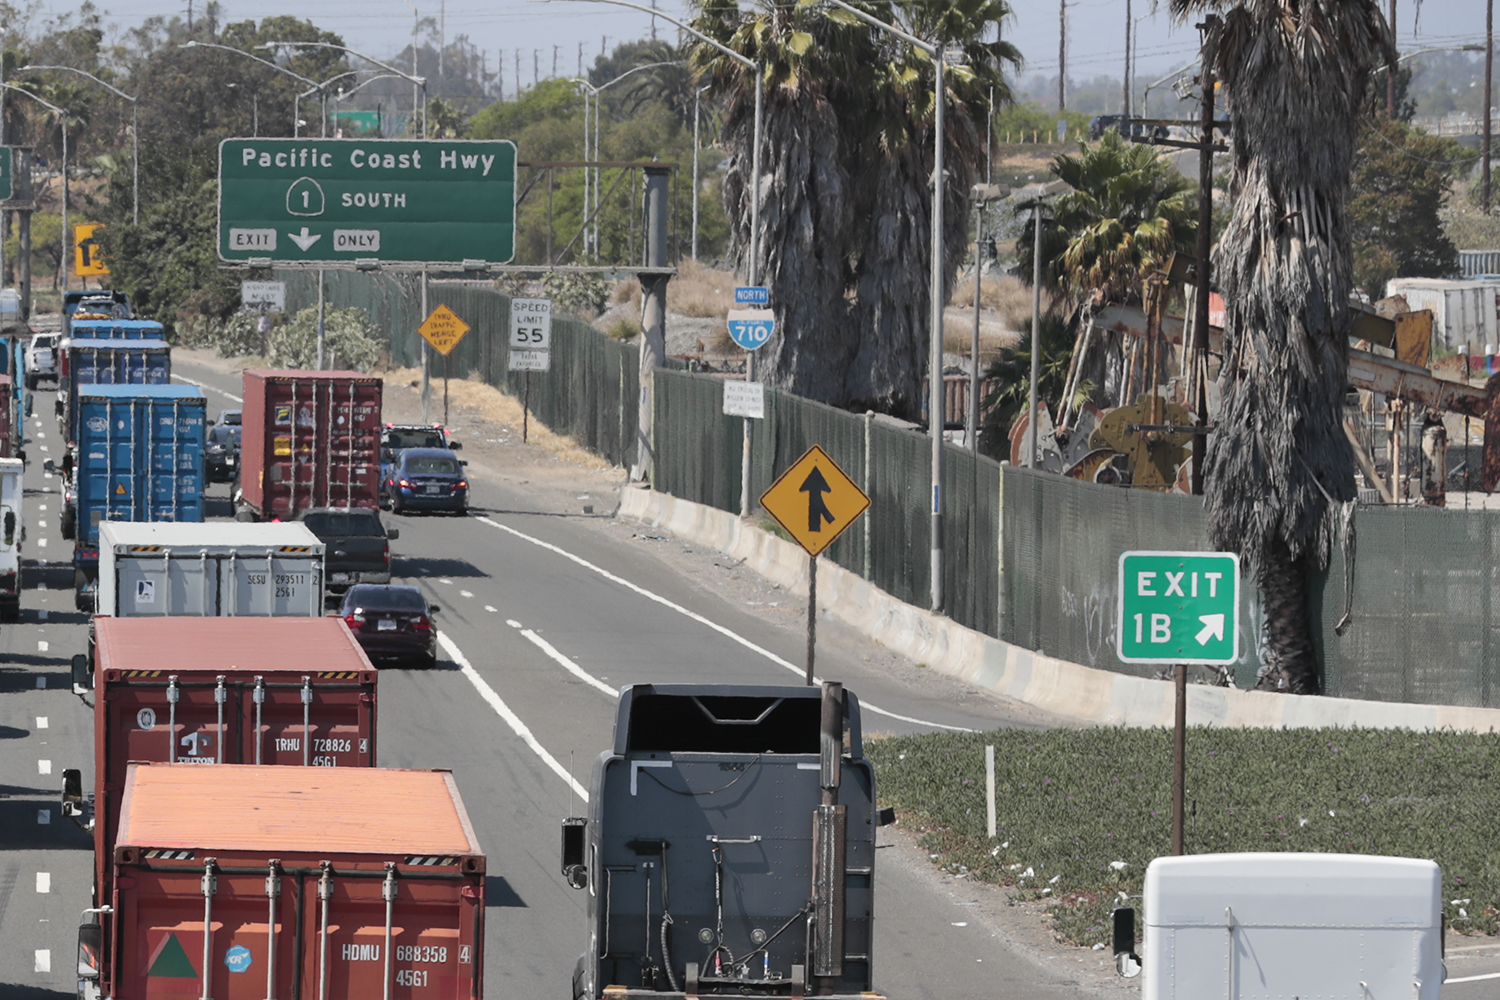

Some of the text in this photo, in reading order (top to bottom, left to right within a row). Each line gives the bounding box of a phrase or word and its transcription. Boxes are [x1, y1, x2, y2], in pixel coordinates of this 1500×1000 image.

[242, 148, 495, 176] Pacific Coast Hwy
[301, 191, 407, 209] 1 SOUTH
[236, 234, 270, 246] EXIT
[337, 235, 376, 247] ONLY
[737, 290, 766, 300] NORTH
[513, 303, 548, 312] SPEED
[517, 316, 543, 324] LIMIT
[517, 328, 543, 342] 55
[735, 326, 768, 341] 710
[248, 575, 318, 586] SESU 293511 2
[1137, 571, 1223, 598] EXIT
[1133, 612, 1172, 643] 1B
[275, 738, 367, 753] TRHU 728826 4
[312, 755, 337, 767] 45G1
[226, 955, 242, 964] KR
[342, 944, 471, 963] HDMU 688358 4
[396, 970, 428, 987] 45G1
